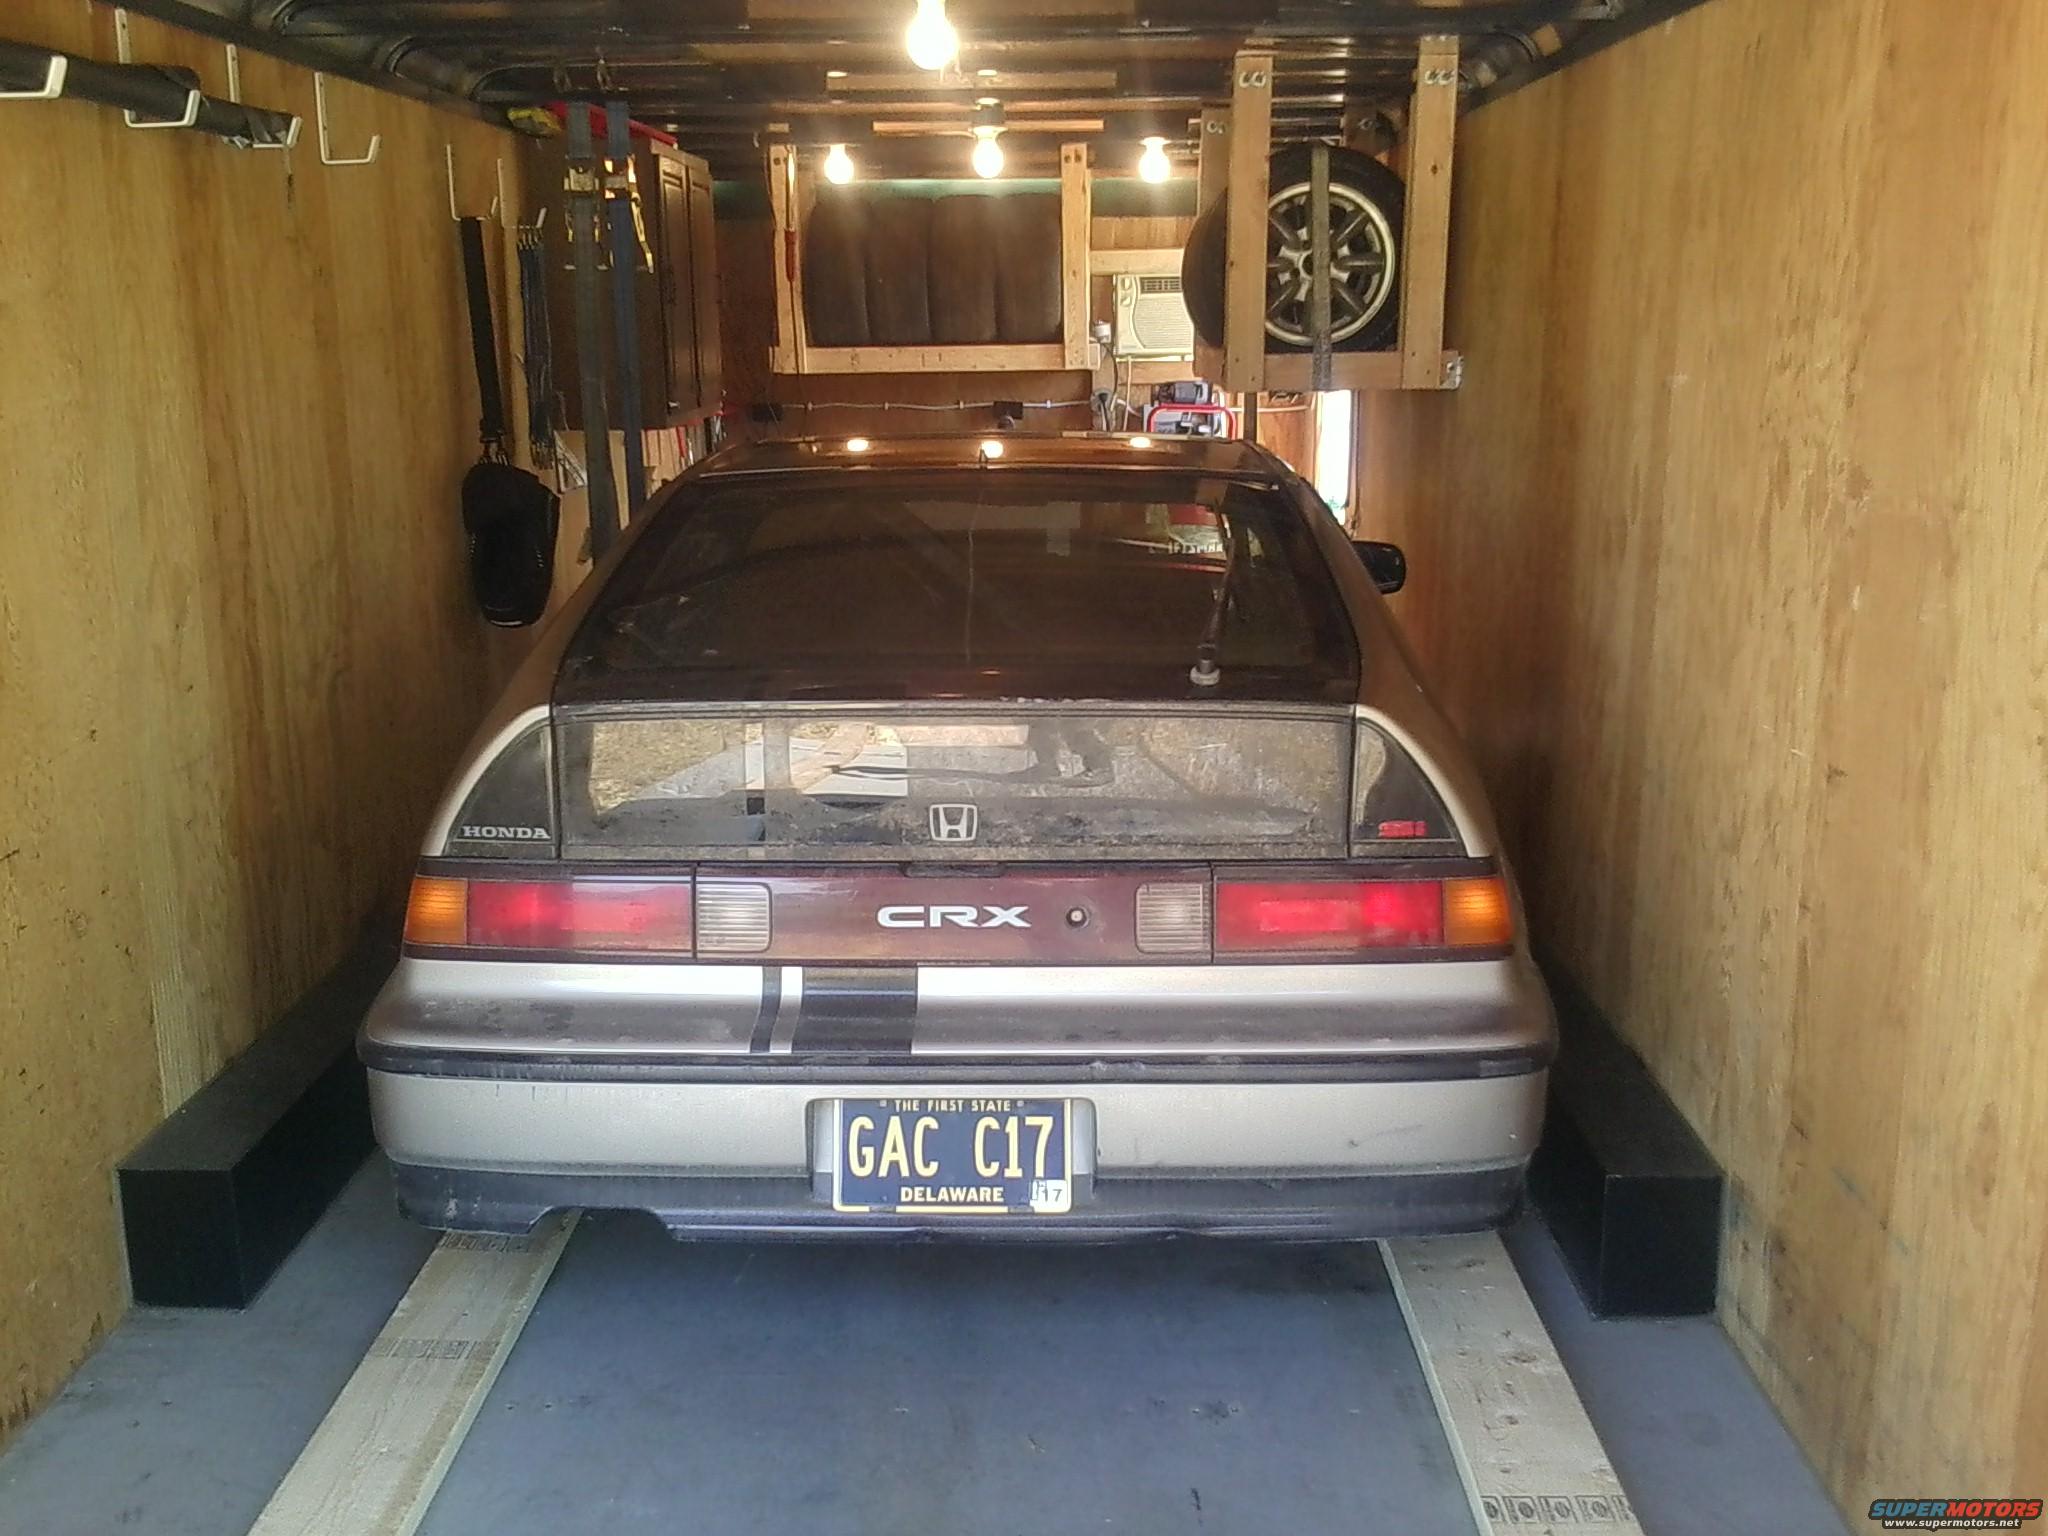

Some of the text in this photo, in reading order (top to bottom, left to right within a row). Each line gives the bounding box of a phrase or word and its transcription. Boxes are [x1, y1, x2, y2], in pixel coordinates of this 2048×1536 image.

[463, 826, 551, 839] HONDA
[877, 905, 1032, 928] CRX
[895, 1100, 1010, 1112] THE FIRST STATE
[849, 1116, 1053, 1178] GAC C17
[901, 1187, 1004, 1202] DELAWARE
